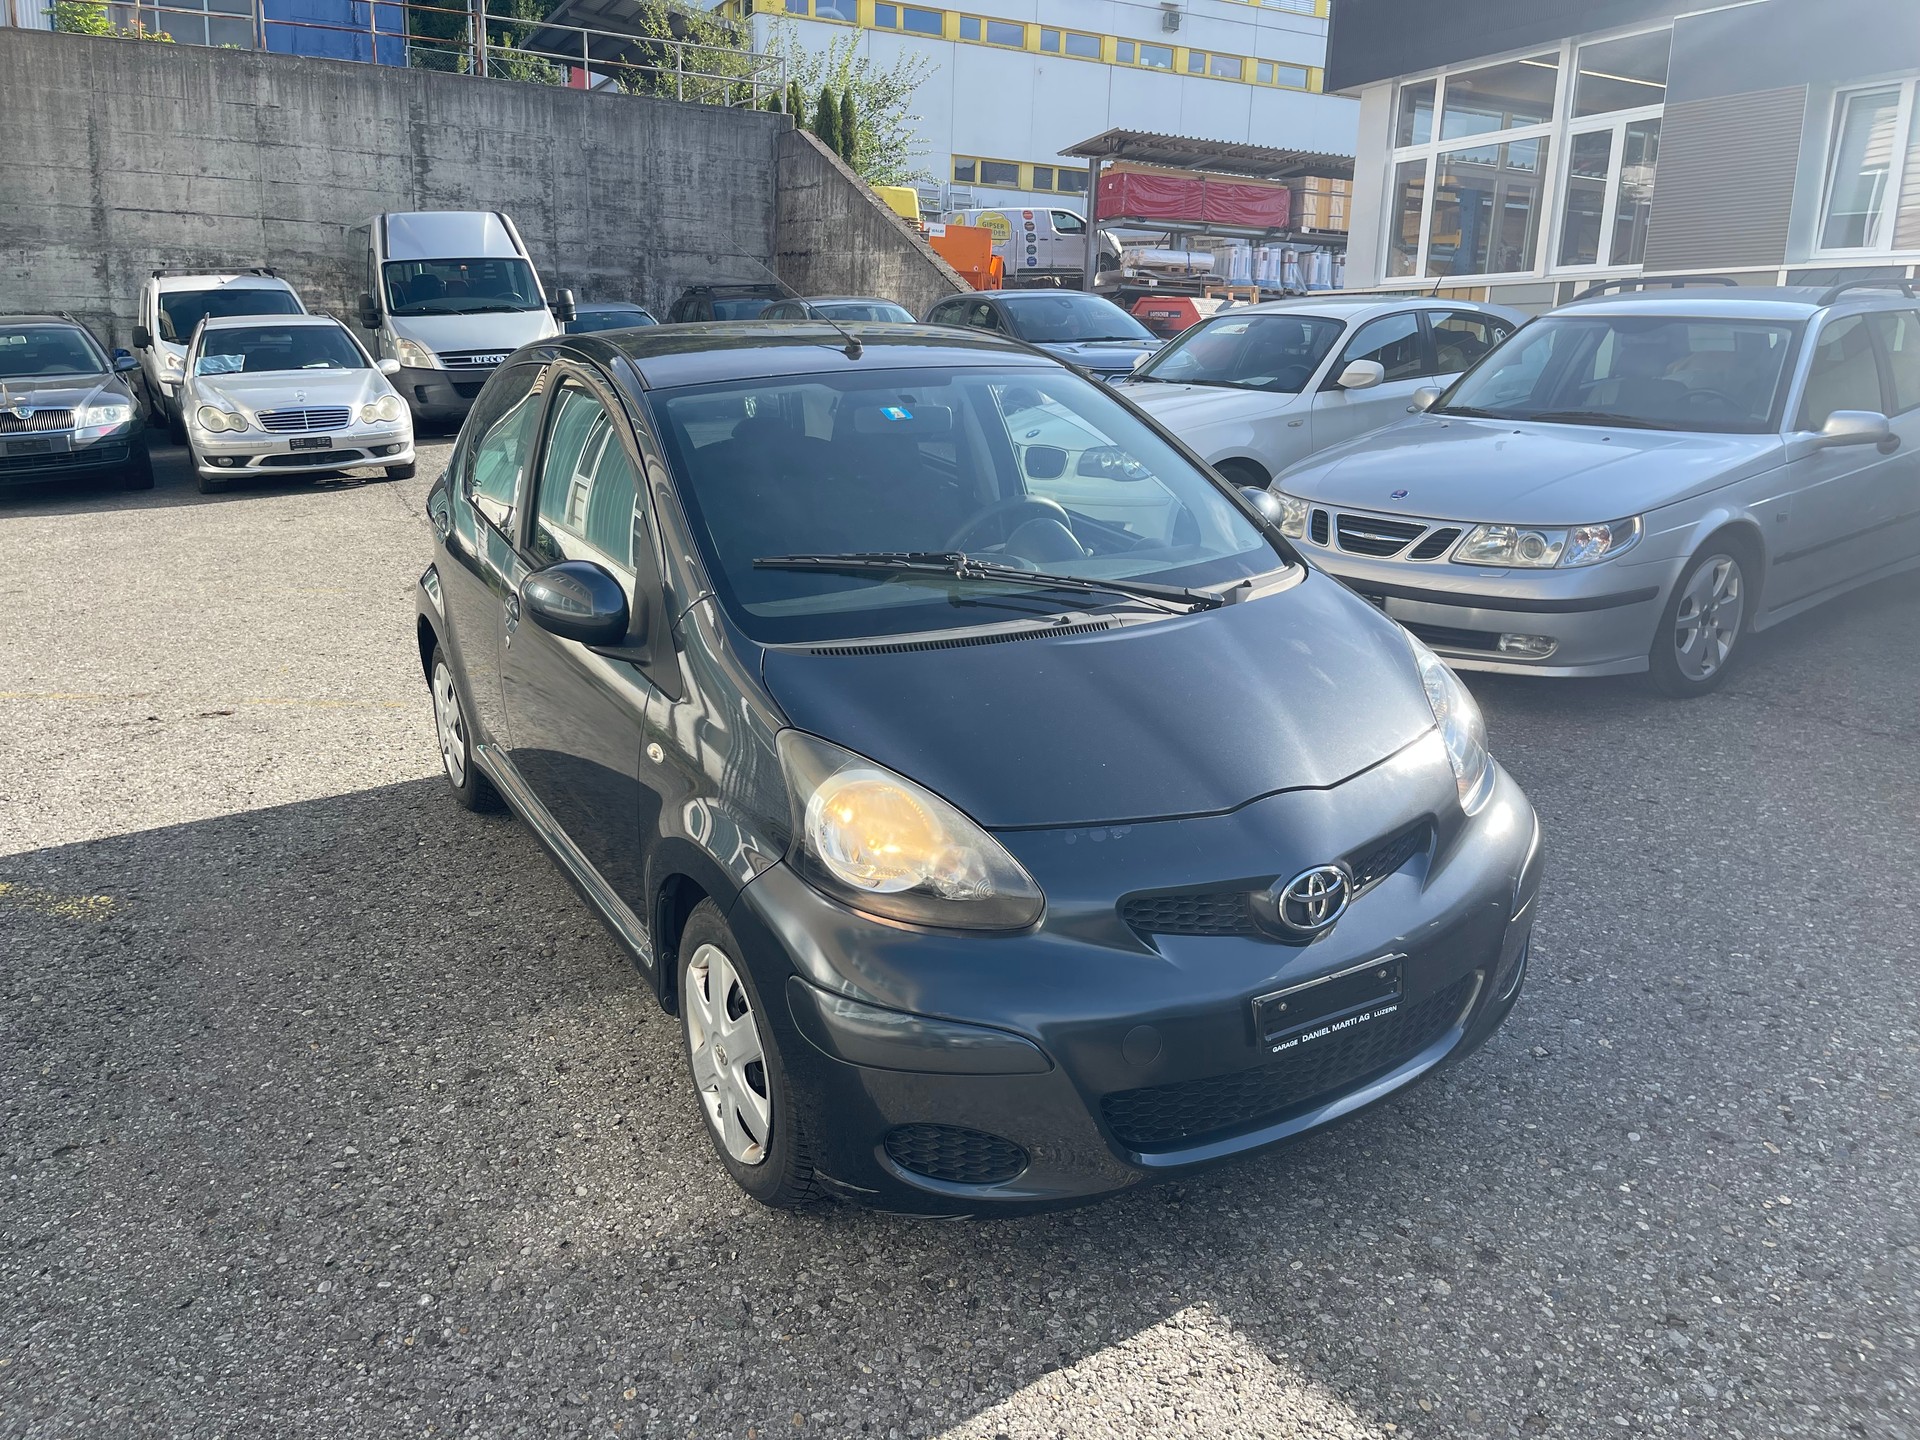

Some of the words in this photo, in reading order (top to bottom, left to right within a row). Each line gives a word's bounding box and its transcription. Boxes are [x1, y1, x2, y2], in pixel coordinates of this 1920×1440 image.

[982, 222, 1005, 230] GIPSER
[471, 354, 507, 364] IVECO
[1272, 1039, 1299, 1053] GARAGE
[1302, 1027, 1331, 1043] DANIEL
[1331, 1018, 1358, 1032] MARTI
[1358, 1013, 1370, 1023] AG
[1374, 1005, 1397, 1018] LUZERN
